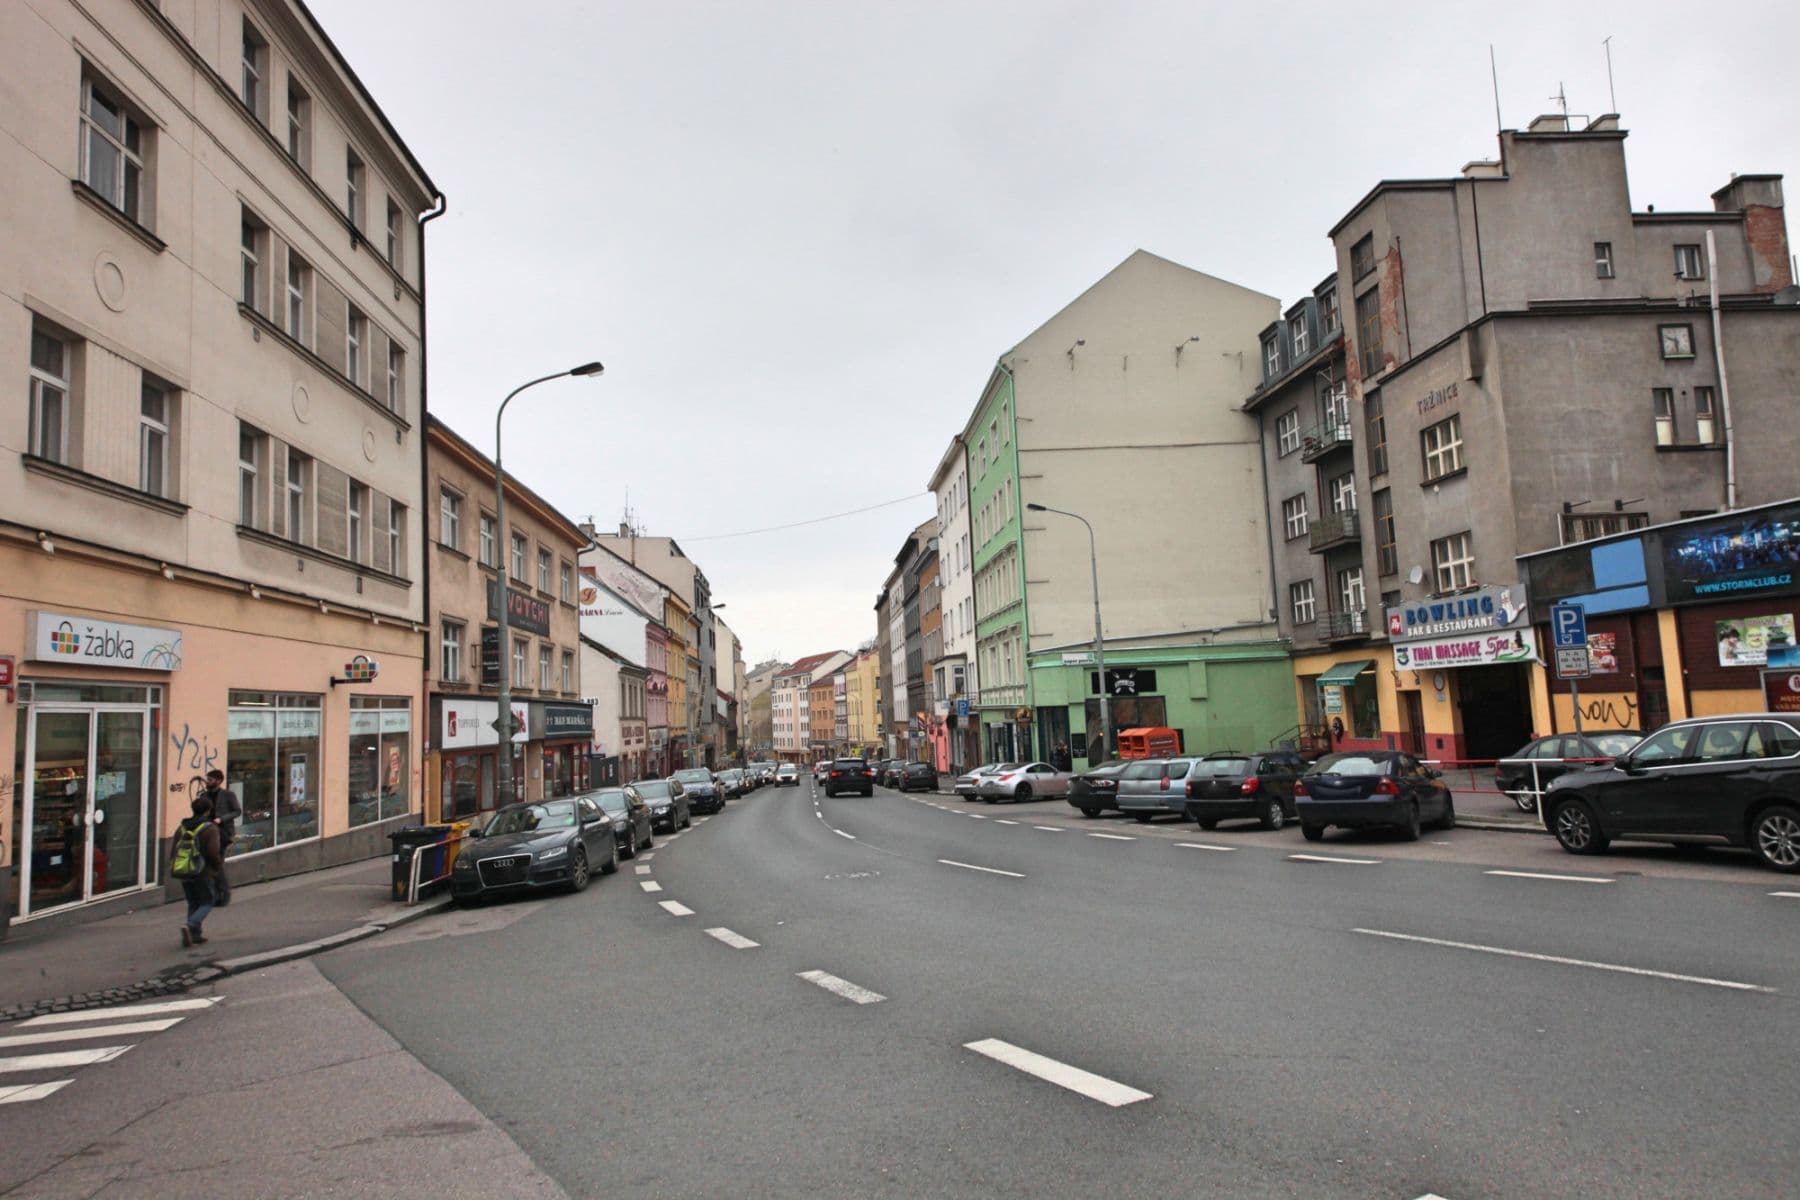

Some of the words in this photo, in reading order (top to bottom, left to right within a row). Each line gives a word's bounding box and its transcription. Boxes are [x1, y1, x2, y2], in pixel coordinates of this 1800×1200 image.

[1694, 574, 1792, 594] WWW.STORMCLUB.CZ
[1406, 596, 1494, 626] BOWLING
[1559, 610, 1577, 634] P
[1407, 626, 1424, 637] BAR
[1426, 624, 1432, 634] &
[1434, 616, 1494, 633] RESTAURANT
[84, 626, 135, 660] žabka
[1412, 644, 1434, 662] THAI
[1435, 640, 1482, 659] MASSAGE
[1485, 635, 1509, 657] Spa
